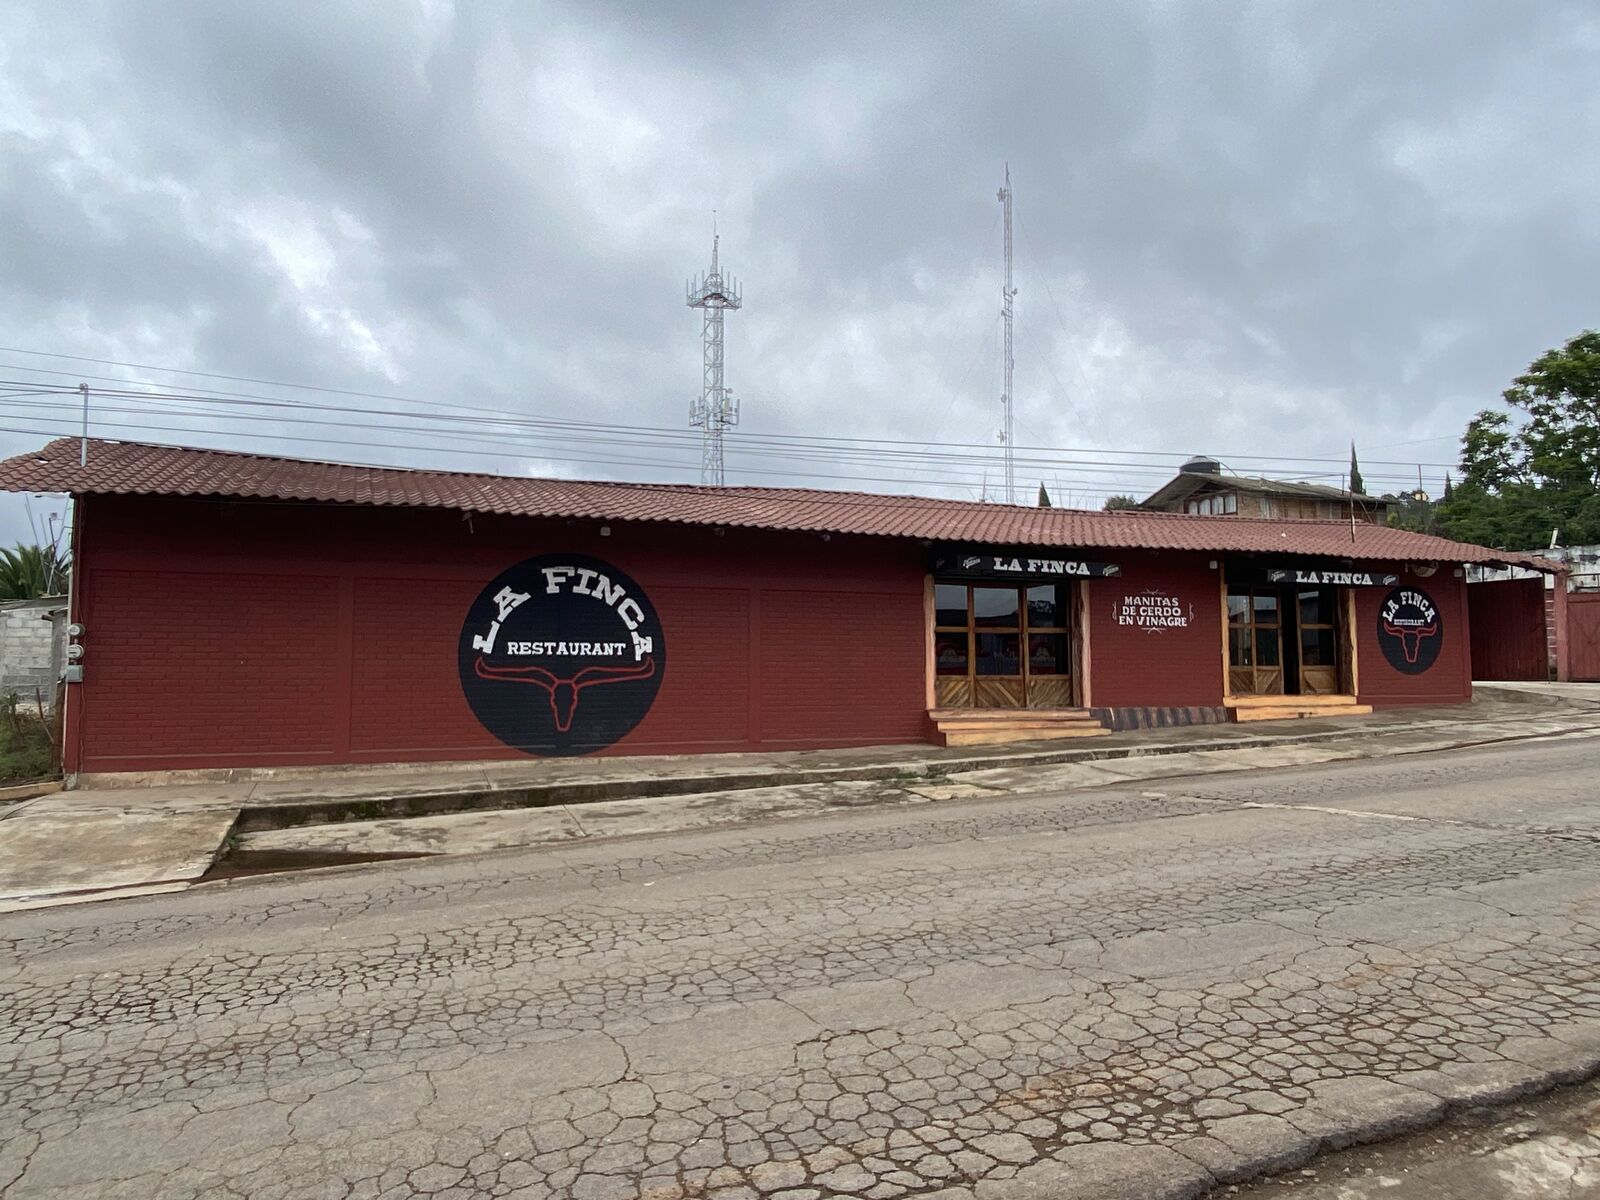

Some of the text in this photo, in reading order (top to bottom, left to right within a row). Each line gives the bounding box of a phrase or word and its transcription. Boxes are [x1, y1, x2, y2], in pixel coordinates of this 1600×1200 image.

[993, 557, 1022, 572] LA
[1027, 559, 1091, 575] FINCA
[1295, 571, 1319, 583] LA
[1321, 571, 1373, 585] FINCA
[1124, 596, 1179, 606] MANITAS
[1382, 591, 1435, 623] LA FINCA
[473, 566, 653, 661] LA FINCA
[1122, 606, 1181, 616] DE CERDO
[1118, 616, 1187, 627] EN VINAGRE
[507, 642, 626, 655] RESTAURANT
